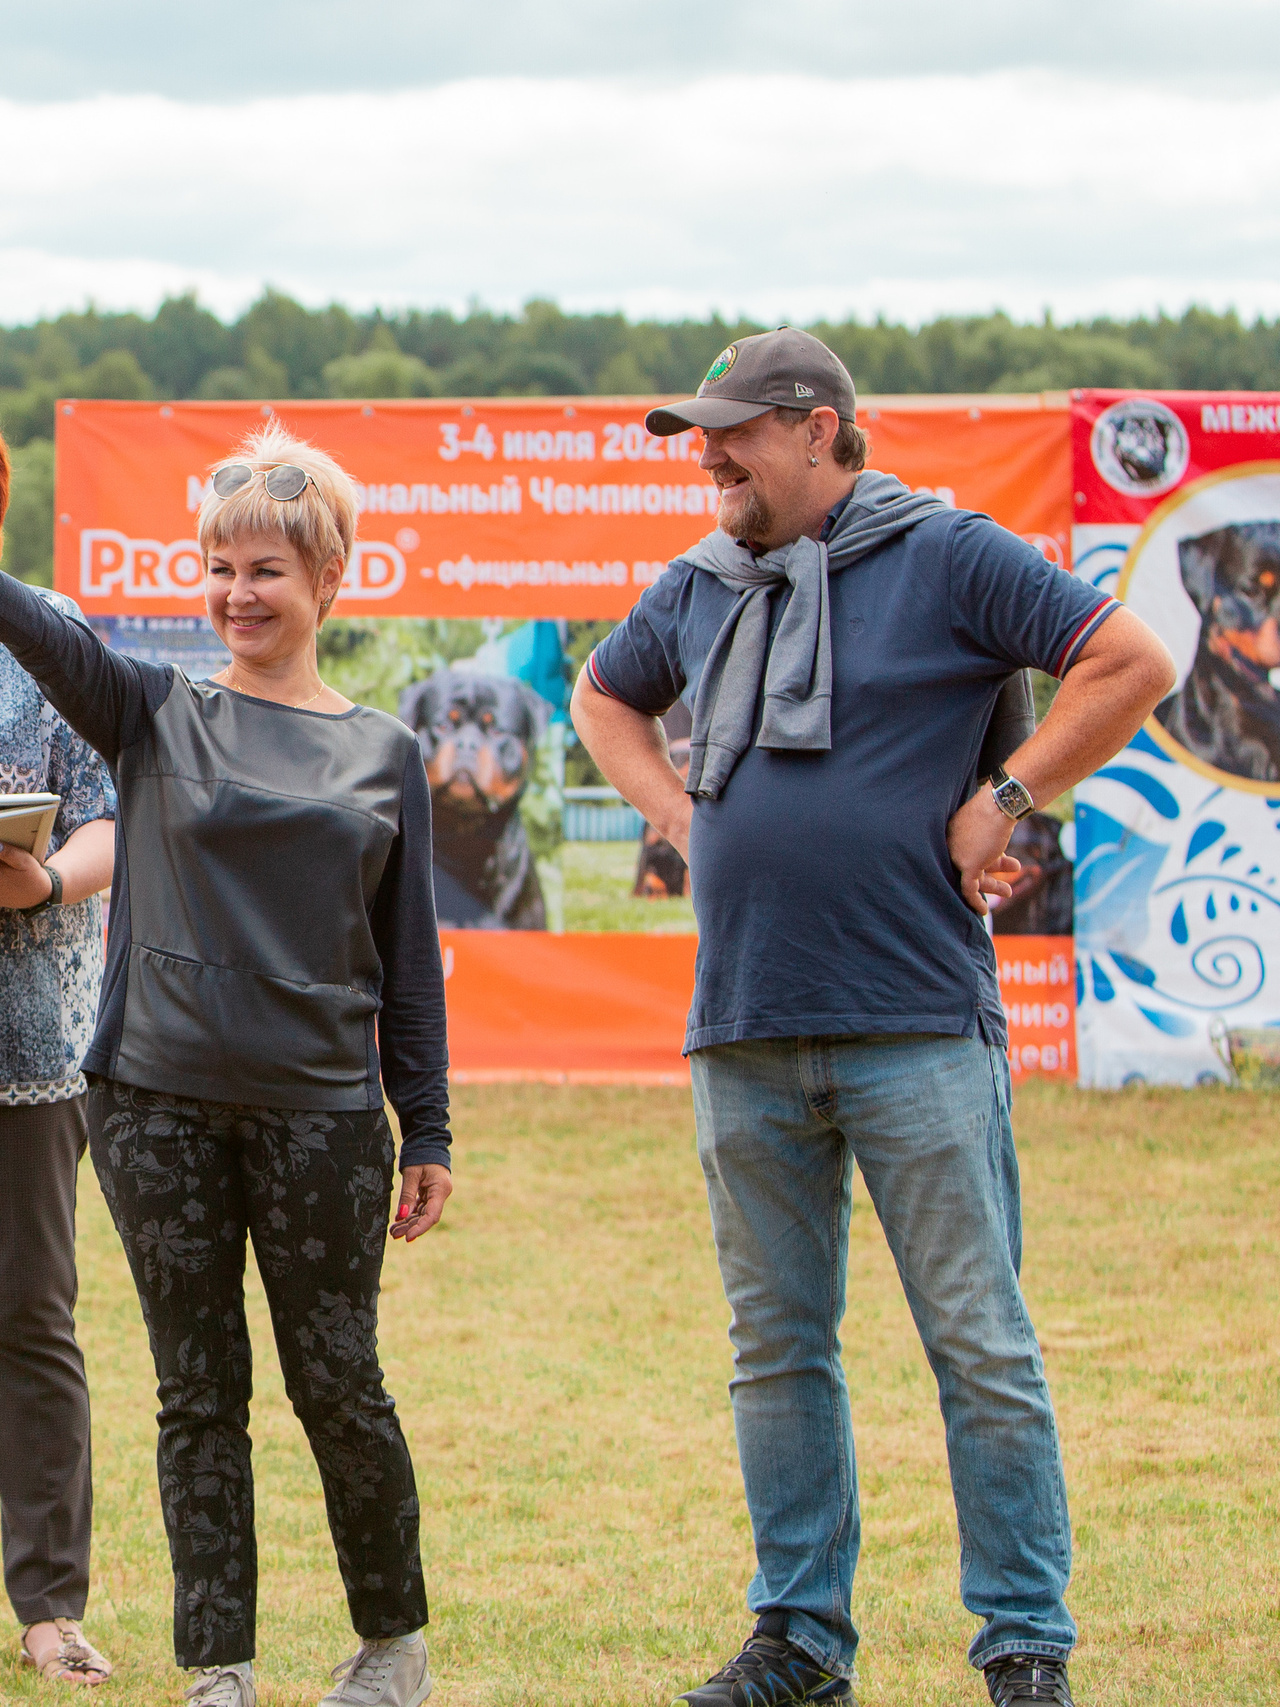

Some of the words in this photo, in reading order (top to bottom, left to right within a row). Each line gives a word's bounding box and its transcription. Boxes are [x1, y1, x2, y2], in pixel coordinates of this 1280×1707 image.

[438, 423, 497, 461] 3-4
[502, 429, 594, 461] июля
[437, 555, 628, 591] официальные
